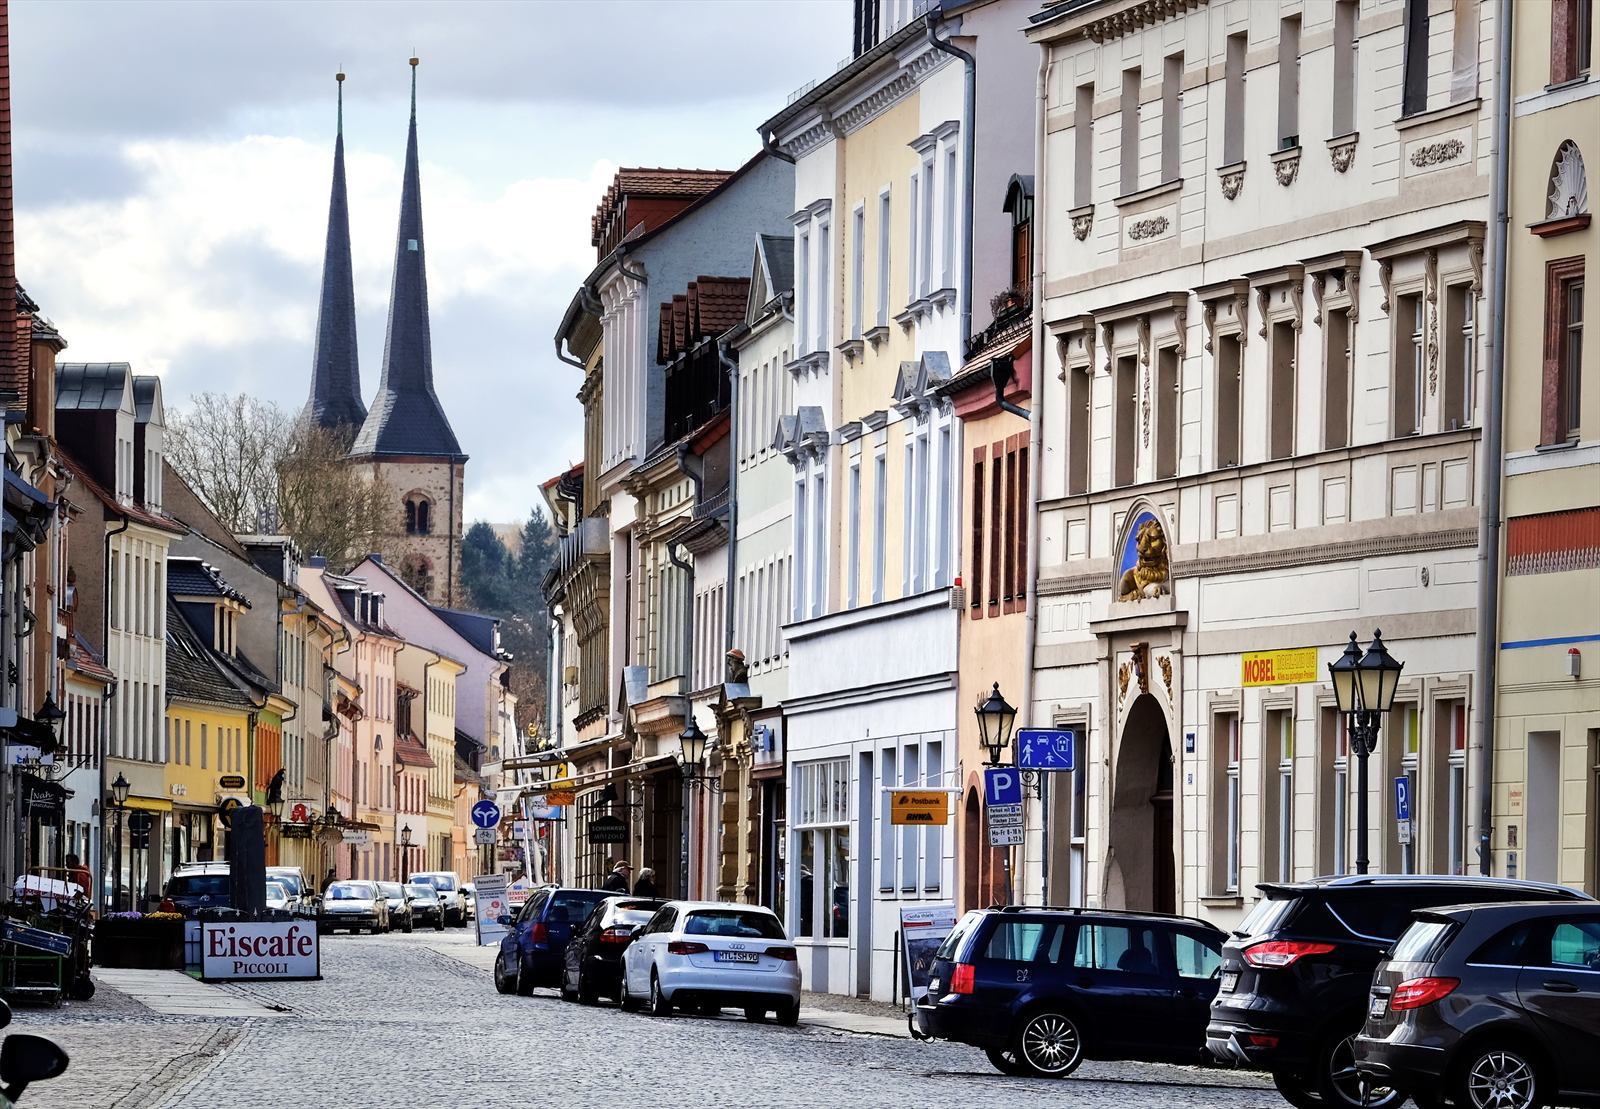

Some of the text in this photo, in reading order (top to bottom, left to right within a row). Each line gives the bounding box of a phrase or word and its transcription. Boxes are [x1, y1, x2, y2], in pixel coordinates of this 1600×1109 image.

[1244, 655, 1275, 682] MÖBEL
[993, 773, 1012, 800] P
[1398, 783, 1406, 815] P
[911, 797, 940, 805] Postbank
[207, 926, 312, 957] Eiscafe
[233, 961, 288, 974] PICCOLI
